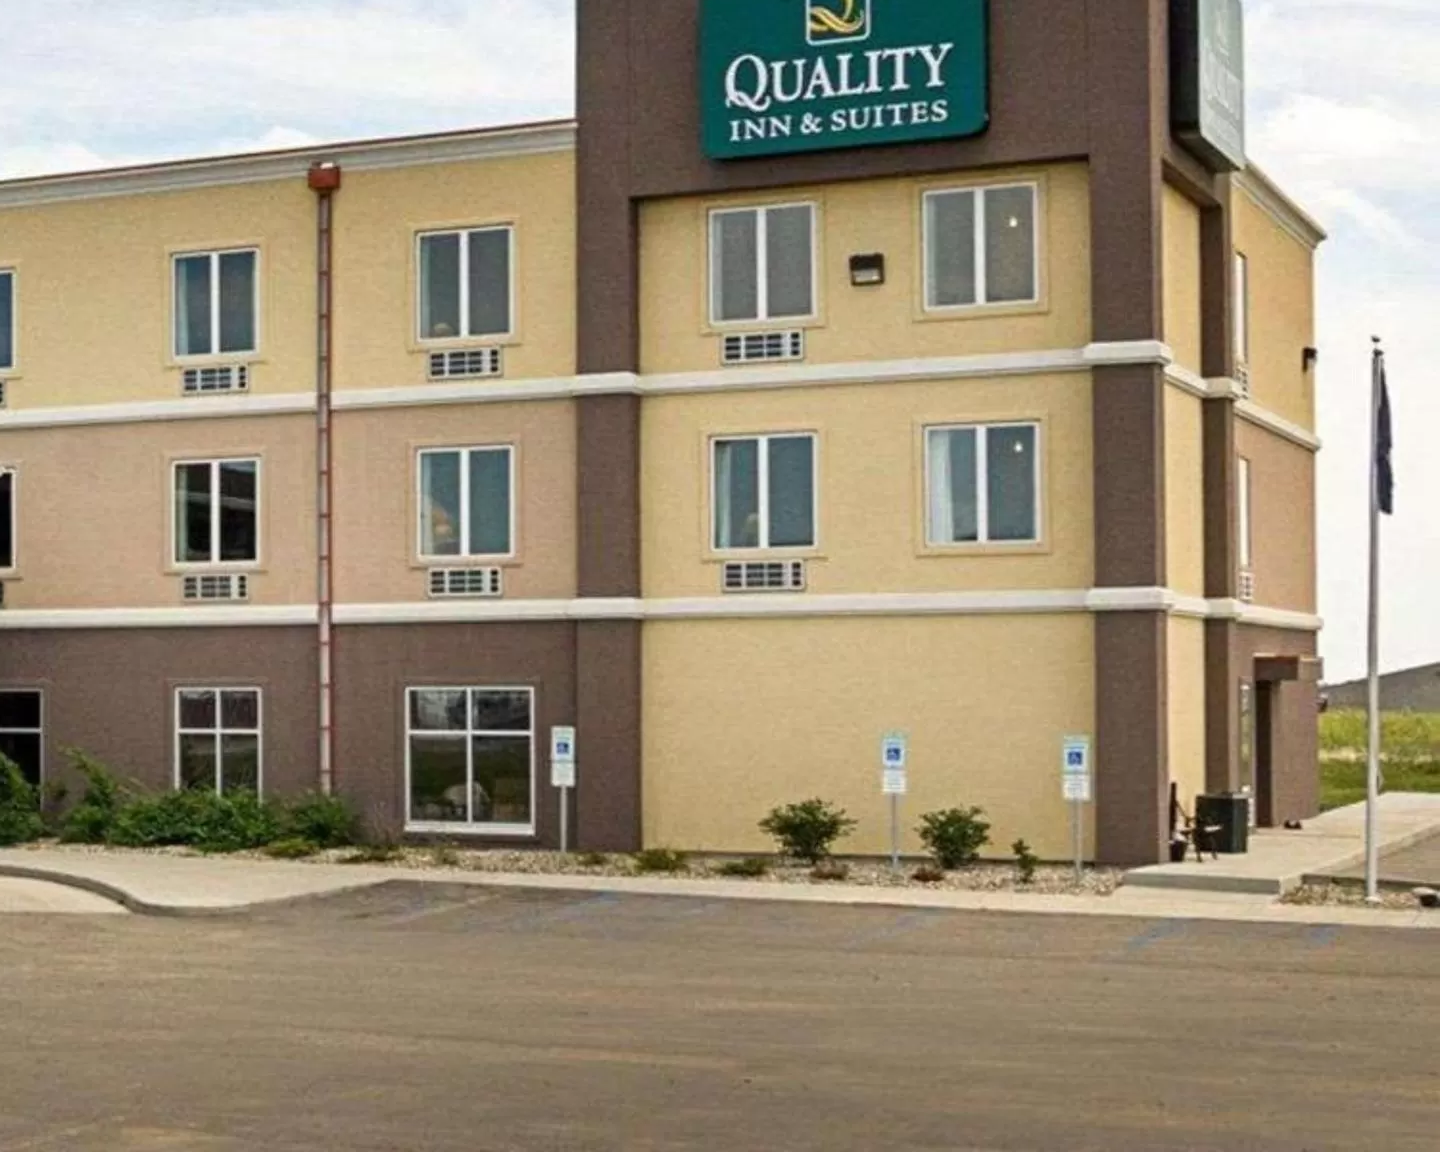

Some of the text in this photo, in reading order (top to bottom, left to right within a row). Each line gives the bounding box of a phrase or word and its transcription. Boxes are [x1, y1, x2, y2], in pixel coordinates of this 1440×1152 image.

[724, 43, 954, 112] QUALITY
[729, 100, 948, 141] INN & SUITES
